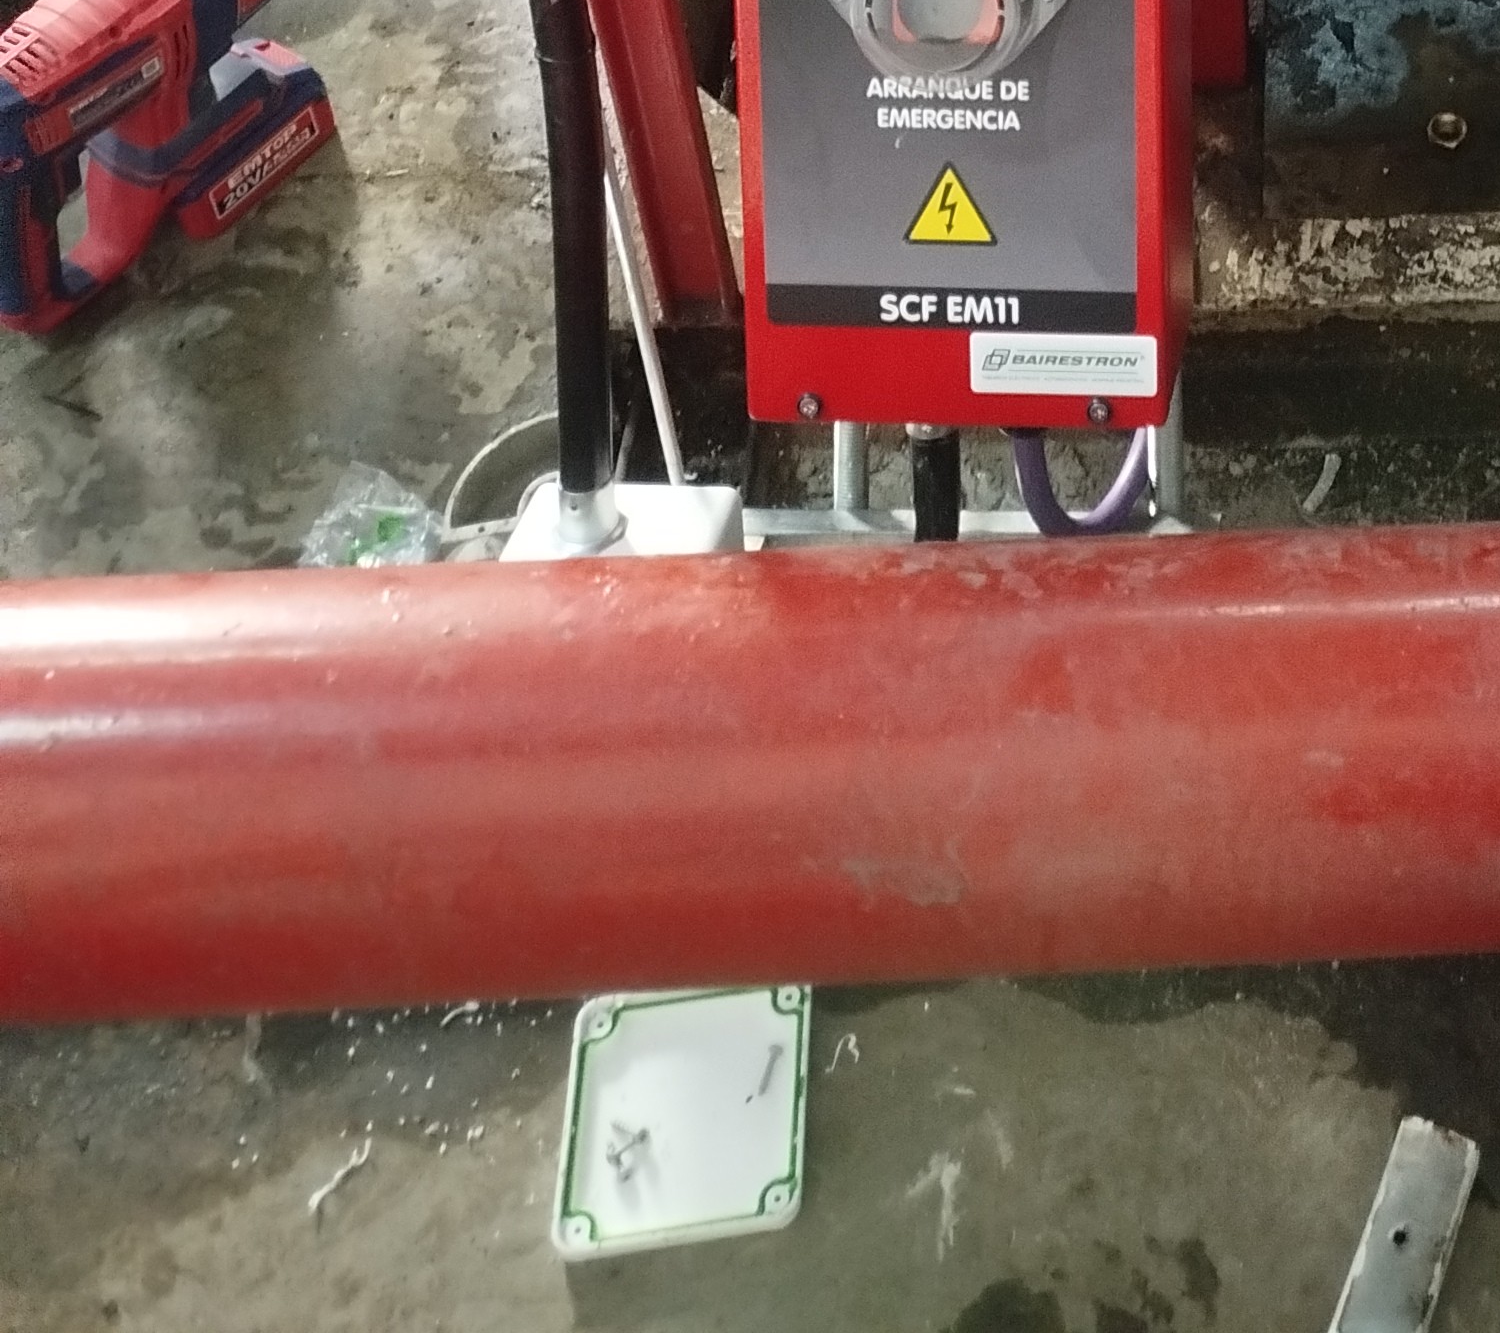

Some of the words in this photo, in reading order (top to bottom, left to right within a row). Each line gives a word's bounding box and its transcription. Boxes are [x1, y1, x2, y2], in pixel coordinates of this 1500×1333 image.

[866, 76, 994, 101] ARRANQUE
[999, 79, 1030, 102] DE
[876, 106, 1021, 131] EMERGENCIA
[227, 123, 297, 190] EMTOP
[879, 293, 938, 323] SCF
[946, 295, 1020, 325] EM11
[1011, 354, 1138, 368] BAIRESTRON
